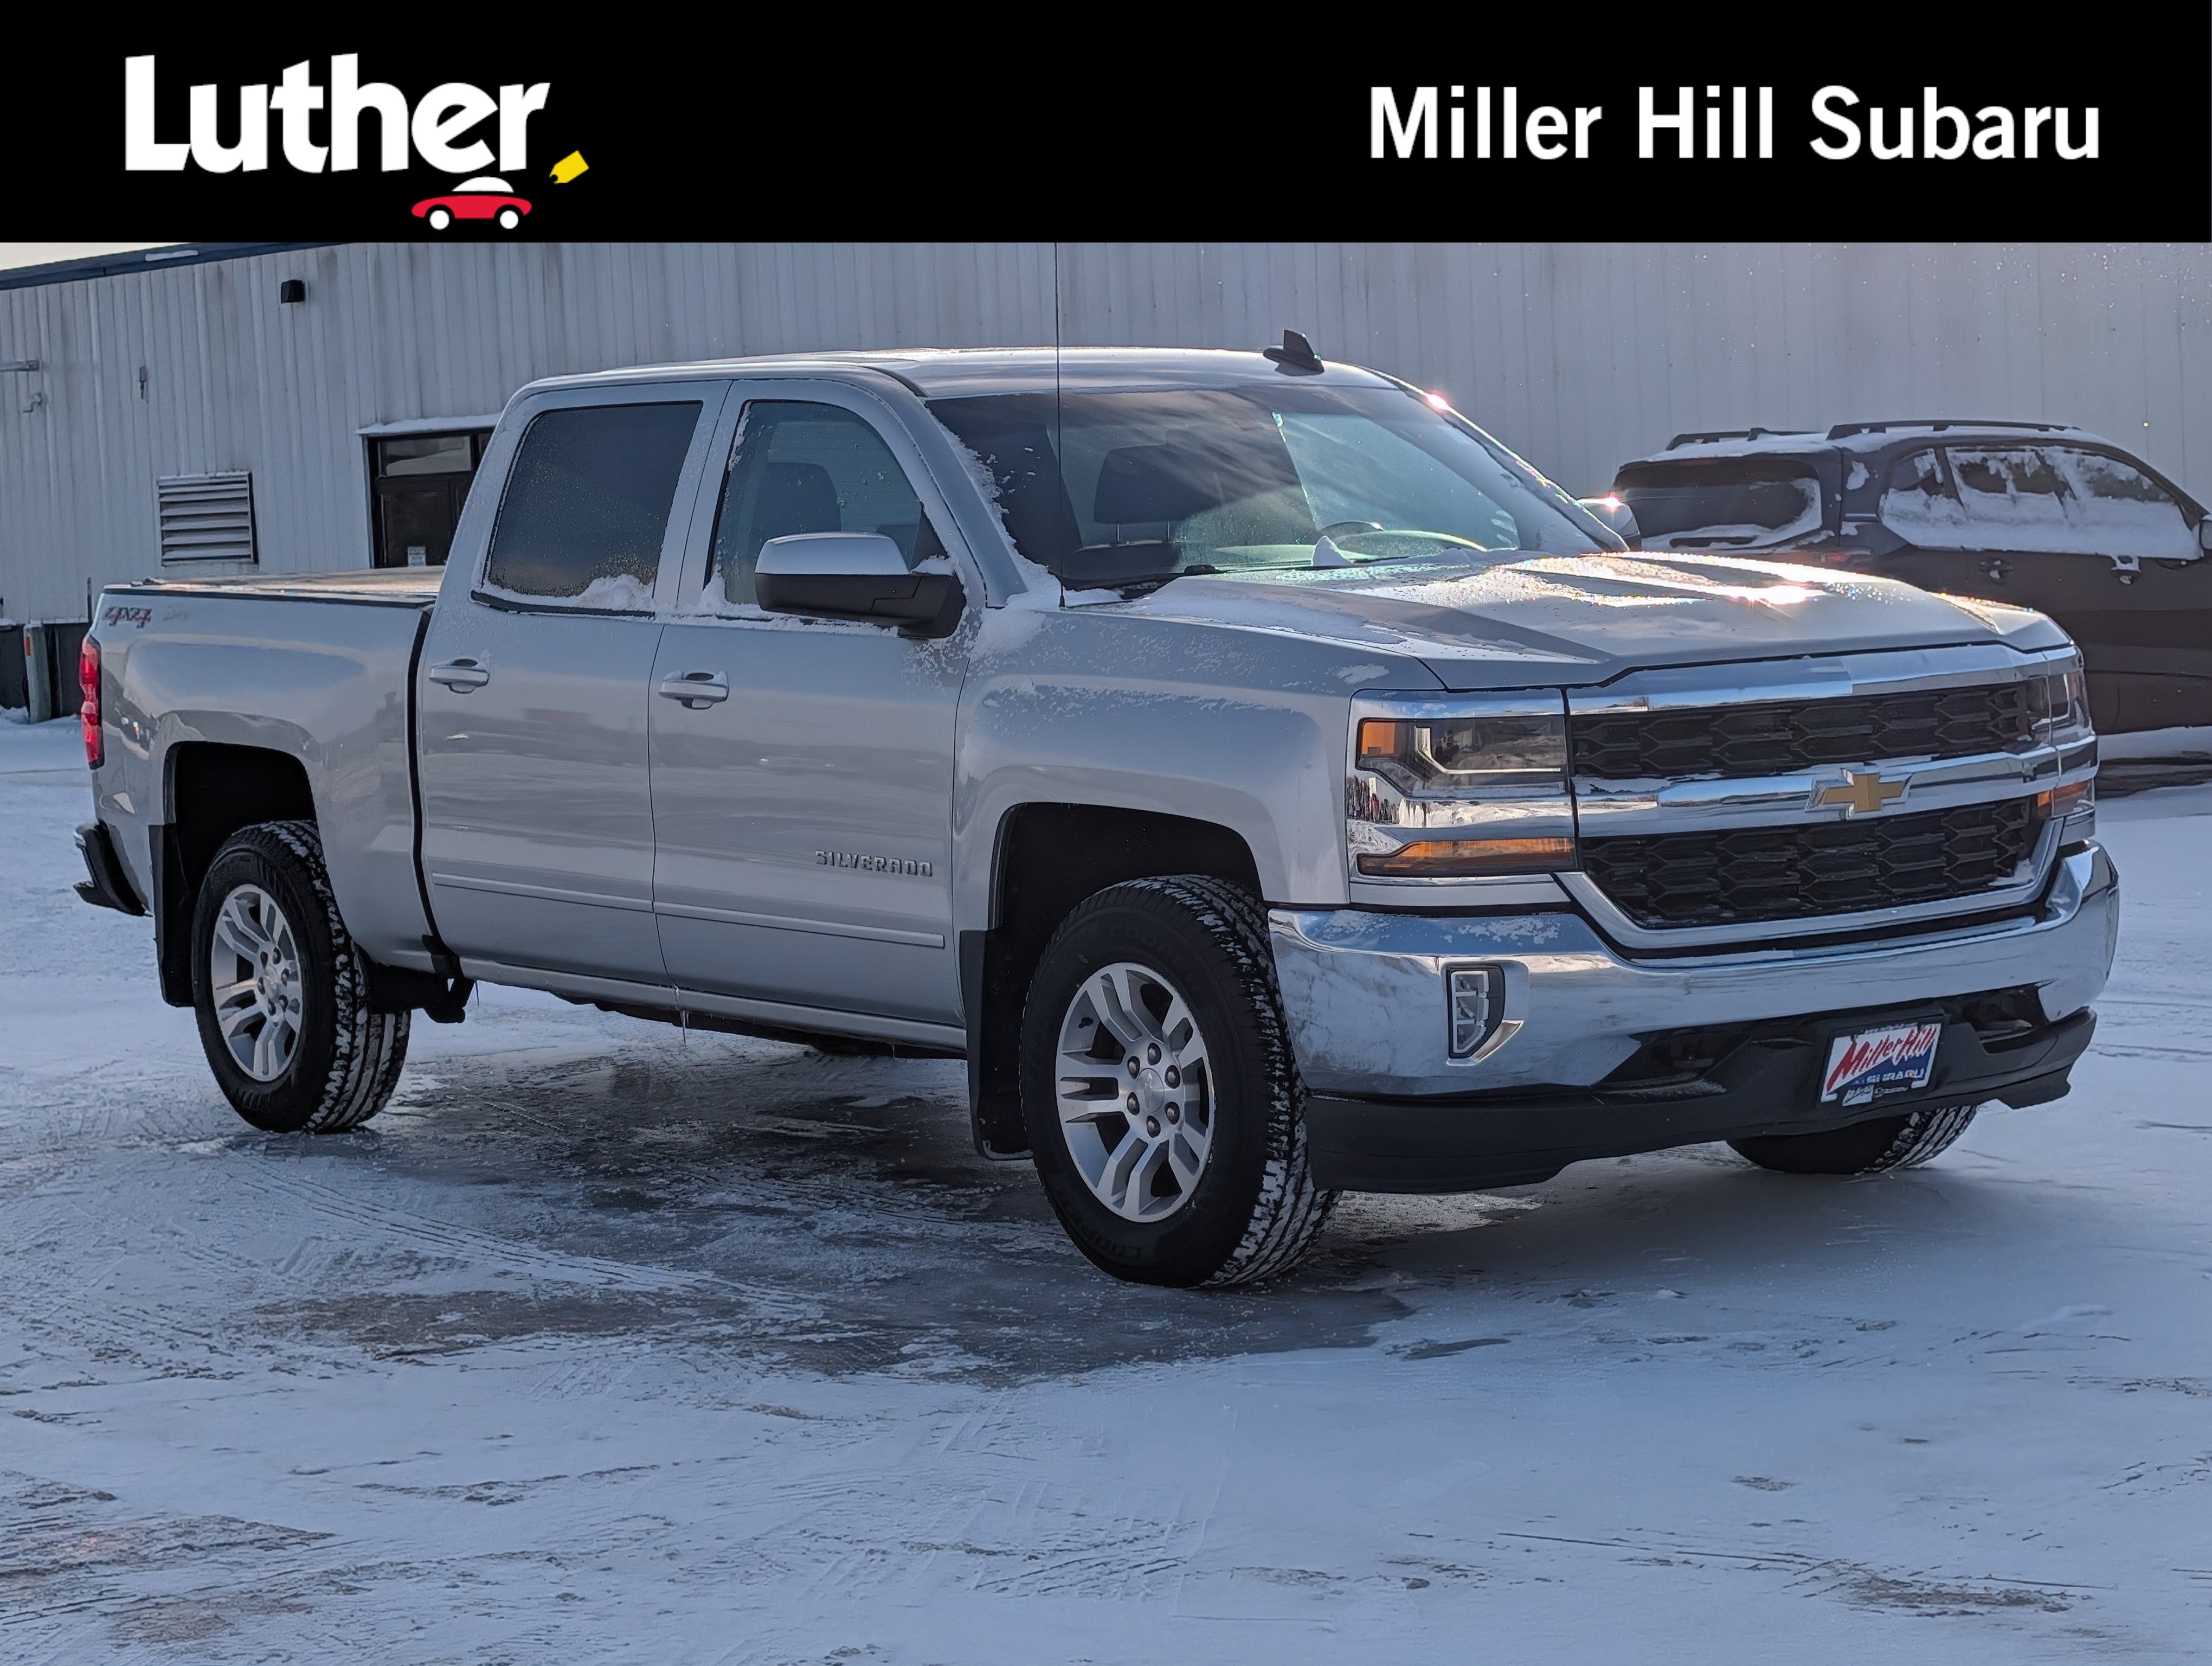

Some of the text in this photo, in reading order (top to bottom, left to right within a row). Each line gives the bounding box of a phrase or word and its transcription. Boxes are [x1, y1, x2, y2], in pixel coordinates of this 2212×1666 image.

[815, 850, 933, 877] SILVERADO
[1826, 1024, 1938, 1092] Miller Hill
